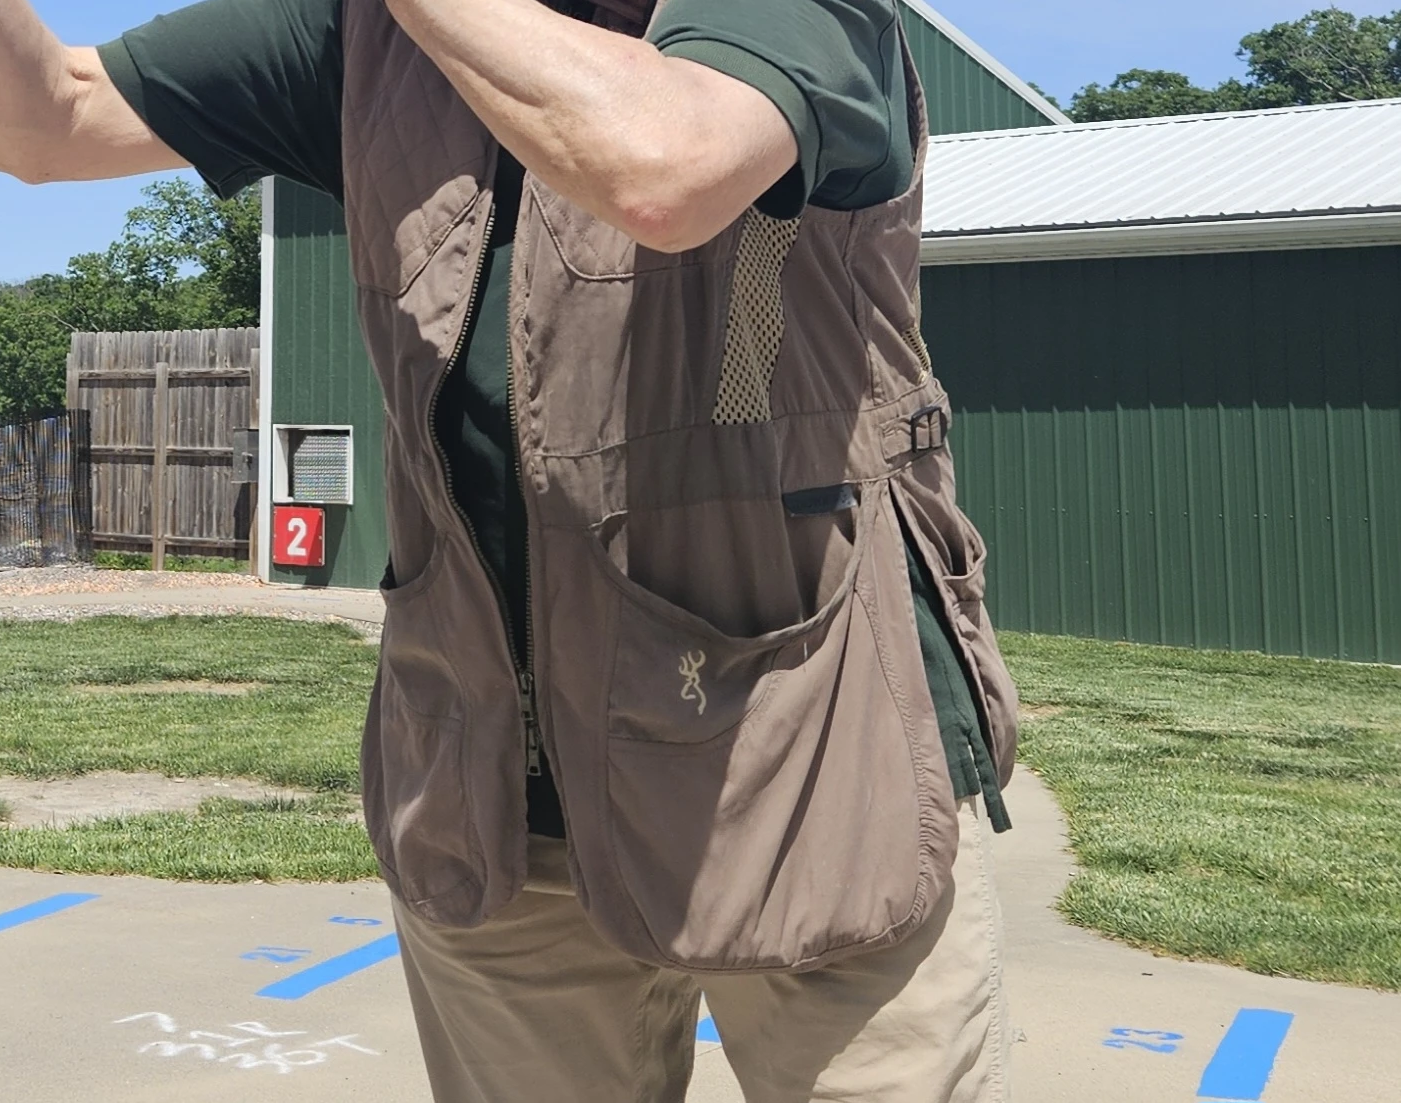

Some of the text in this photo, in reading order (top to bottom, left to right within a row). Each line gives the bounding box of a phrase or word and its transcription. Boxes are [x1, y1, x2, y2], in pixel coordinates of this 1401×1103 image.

[287, 517, 307, 556] 2
[239, 946, 313, 963] 21
[1102, 1028, 1185, 1053] 23
